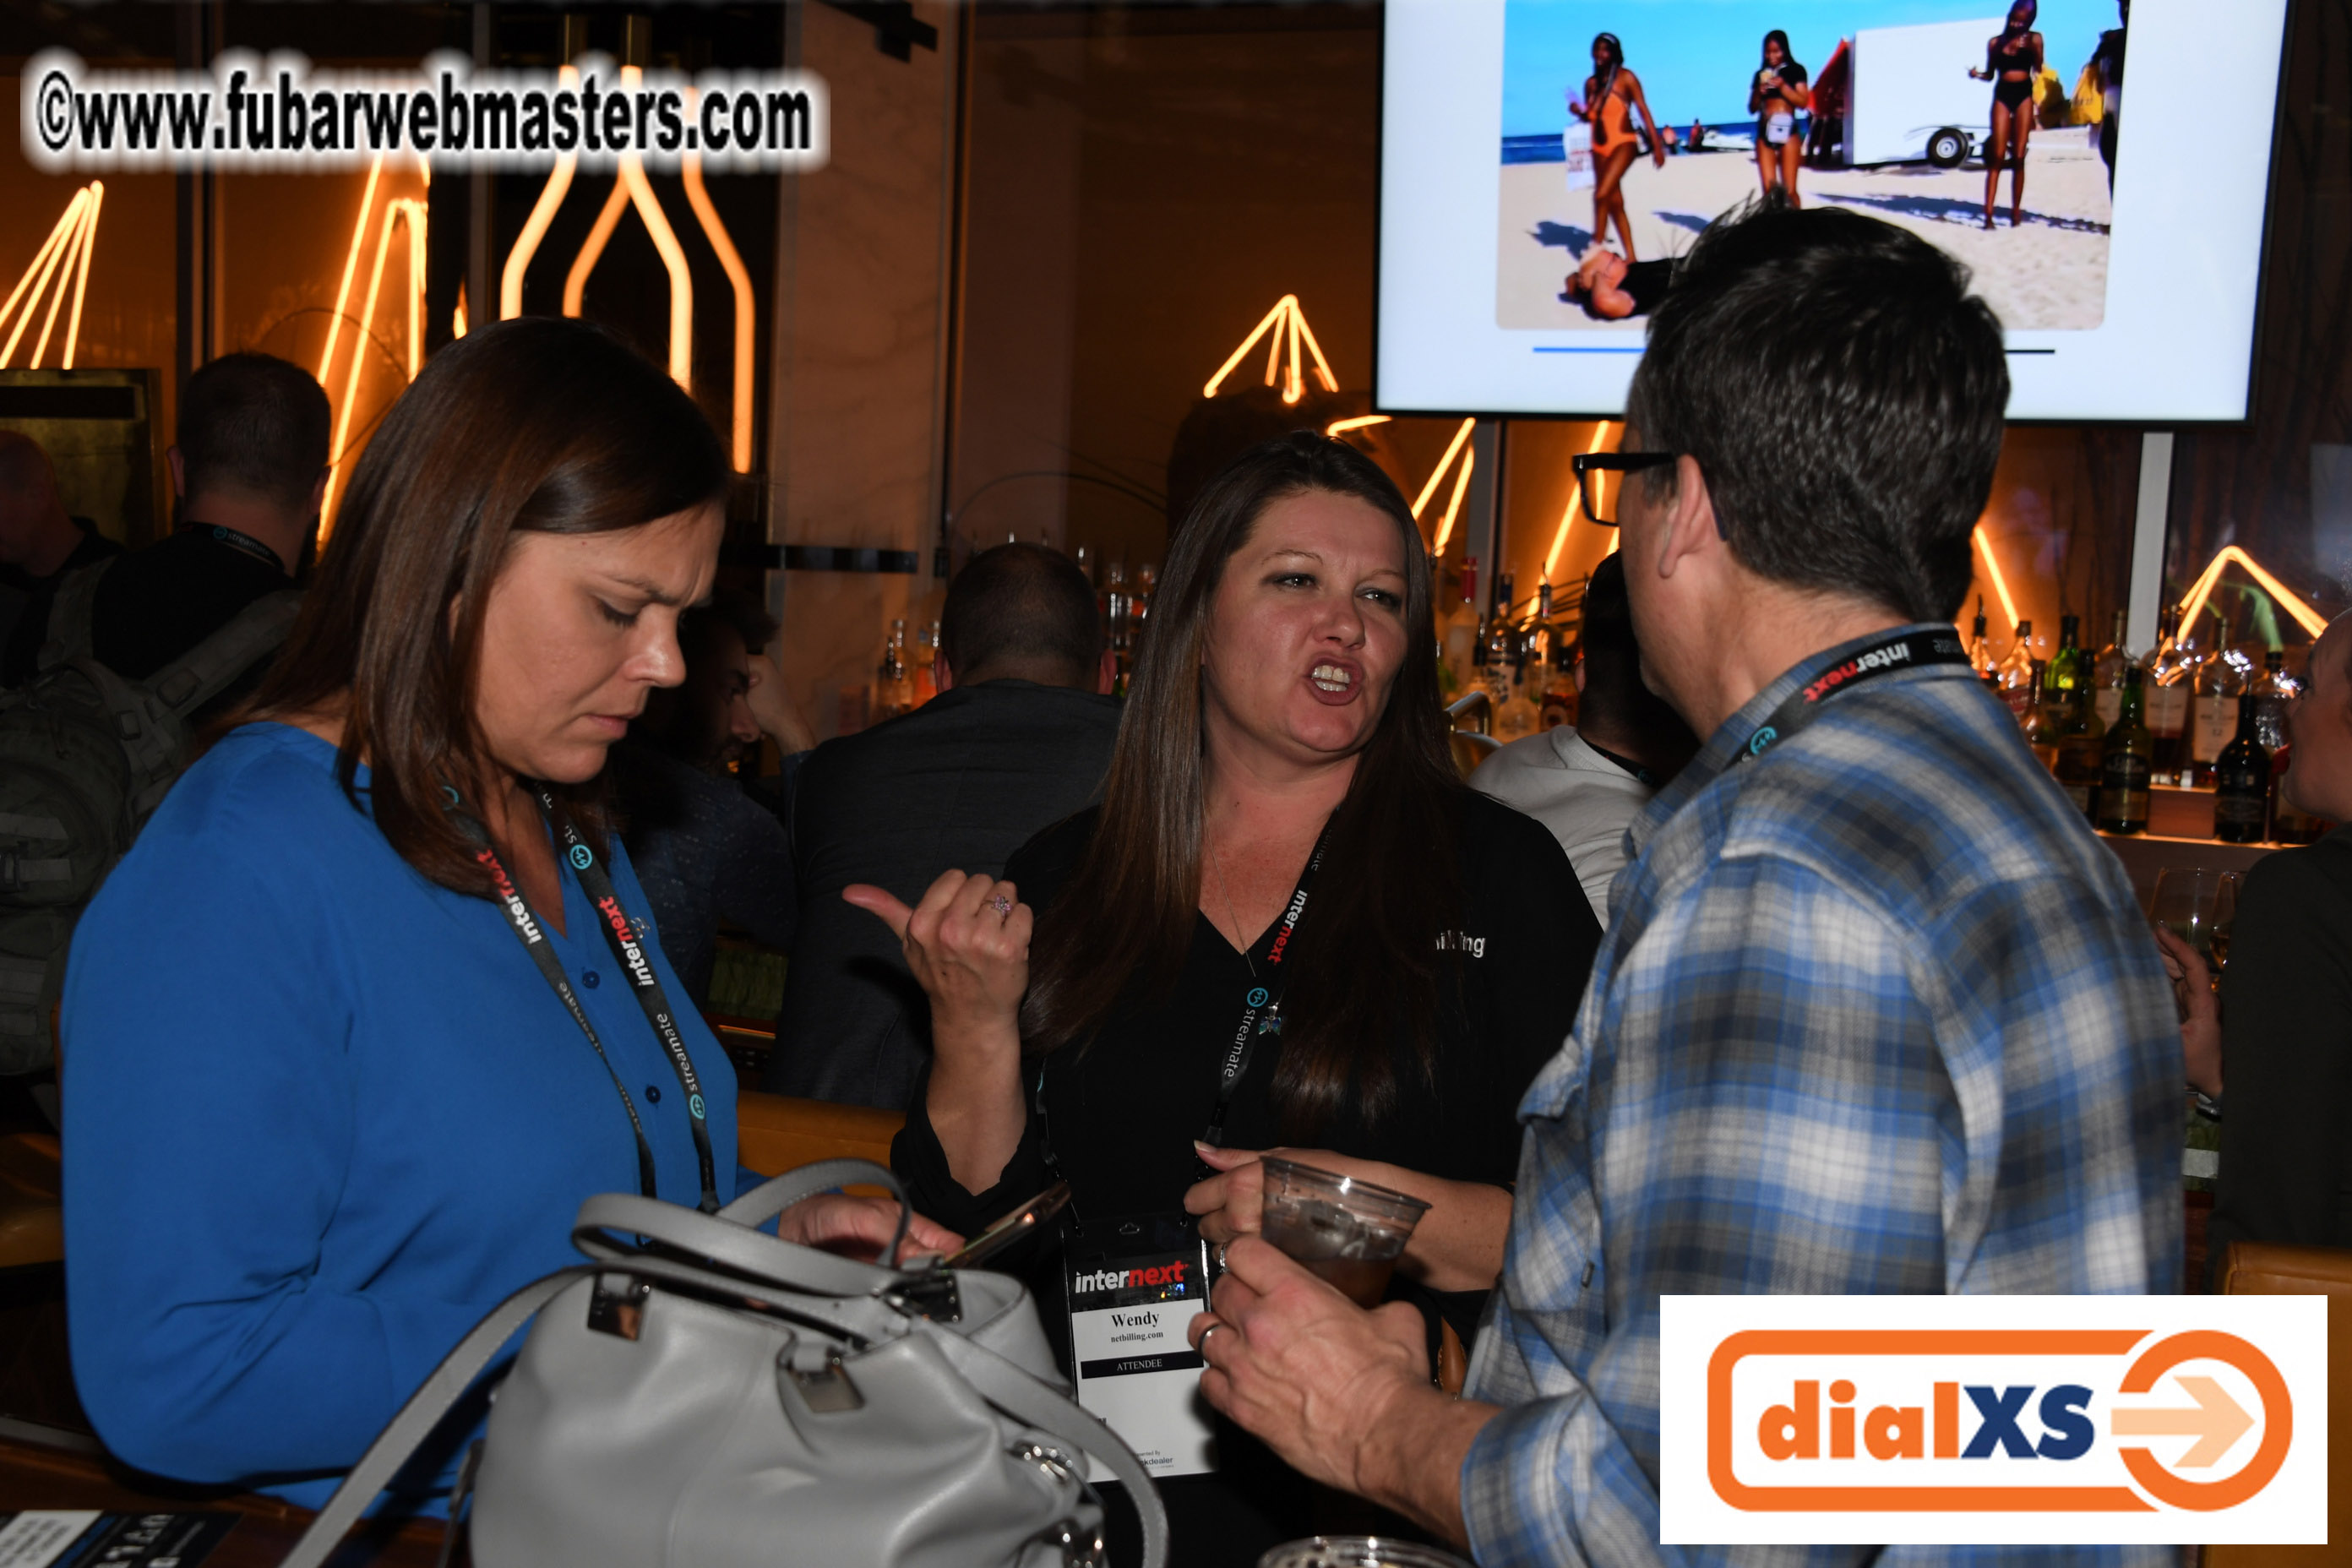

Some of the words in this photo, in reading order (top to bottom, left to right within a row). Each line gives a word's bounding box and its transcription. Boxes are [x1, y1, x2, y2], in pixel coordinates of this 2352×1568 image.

[1802, 640, 1911, 705] internext
[475, 848, 542, 945] internext
[1266, 888, 1309, 965] internext
[597, 896, 654, 987] internext
[656, 1013, 698, 1092] streamate
[1223, 1007, 1255, 1079] streamate
[1075, 1260, 1186, 1293] internext
[1110, 1330, 1163, 1343] netbilling.com
[1111, 1311, 1160, 1329] Wendy
[1116, 1358, 1162, 1371] ATTENDEE
